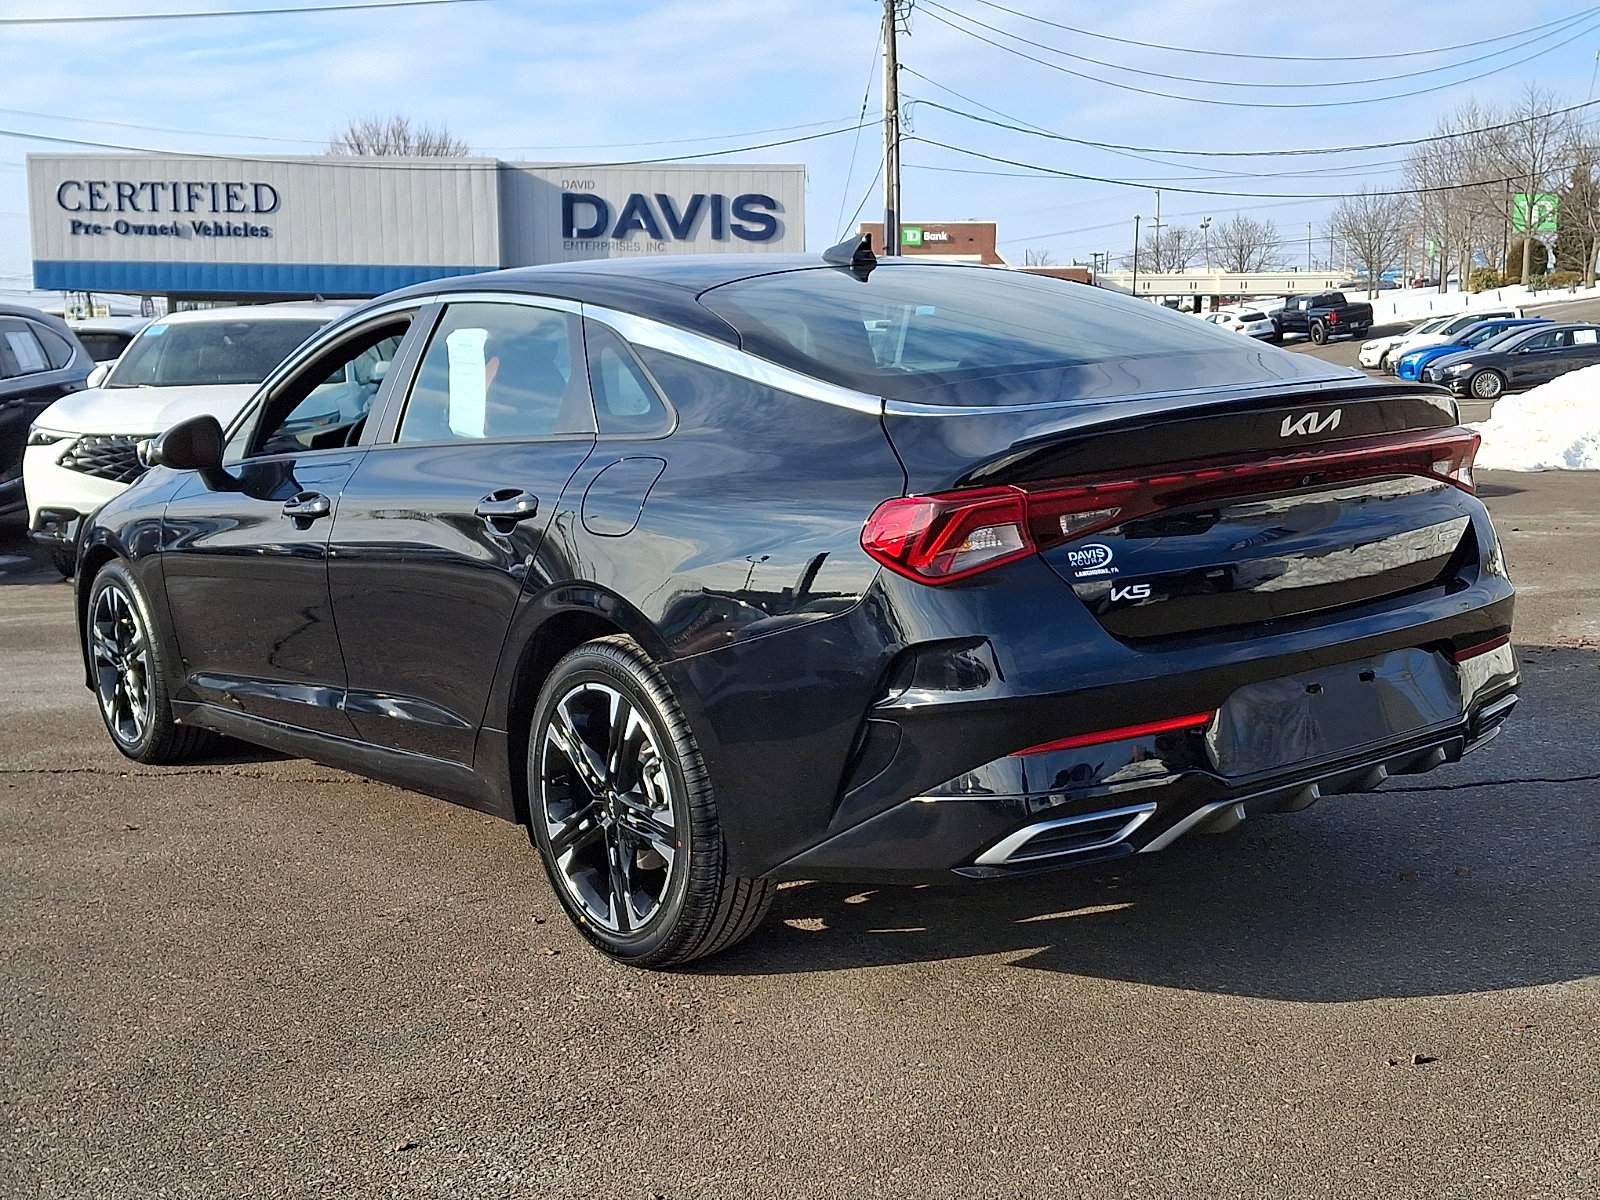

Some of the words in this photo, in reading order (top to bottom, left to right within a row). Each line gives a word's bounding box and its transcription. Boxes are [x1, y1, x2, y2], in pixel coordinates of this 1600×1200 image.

[561, 180, 595, 190] DAVID
[57, 180, 279, 213] CERTIFIED
[561, 192, 779, 241] DAVIS
[70, 219, 179, 236] Pre-Owned
[191, 219, 271, 237] Vehicles
[903, 229, 920, 242] TD
[923, 230, 948, 241] Bank
[1280, 409, 1342, 437] KIA
[1067, 548, 1105, 561] DAVIS
[1070, 557, 1104, 567] ACURA
[1110, 584, 1151, 602] K5
